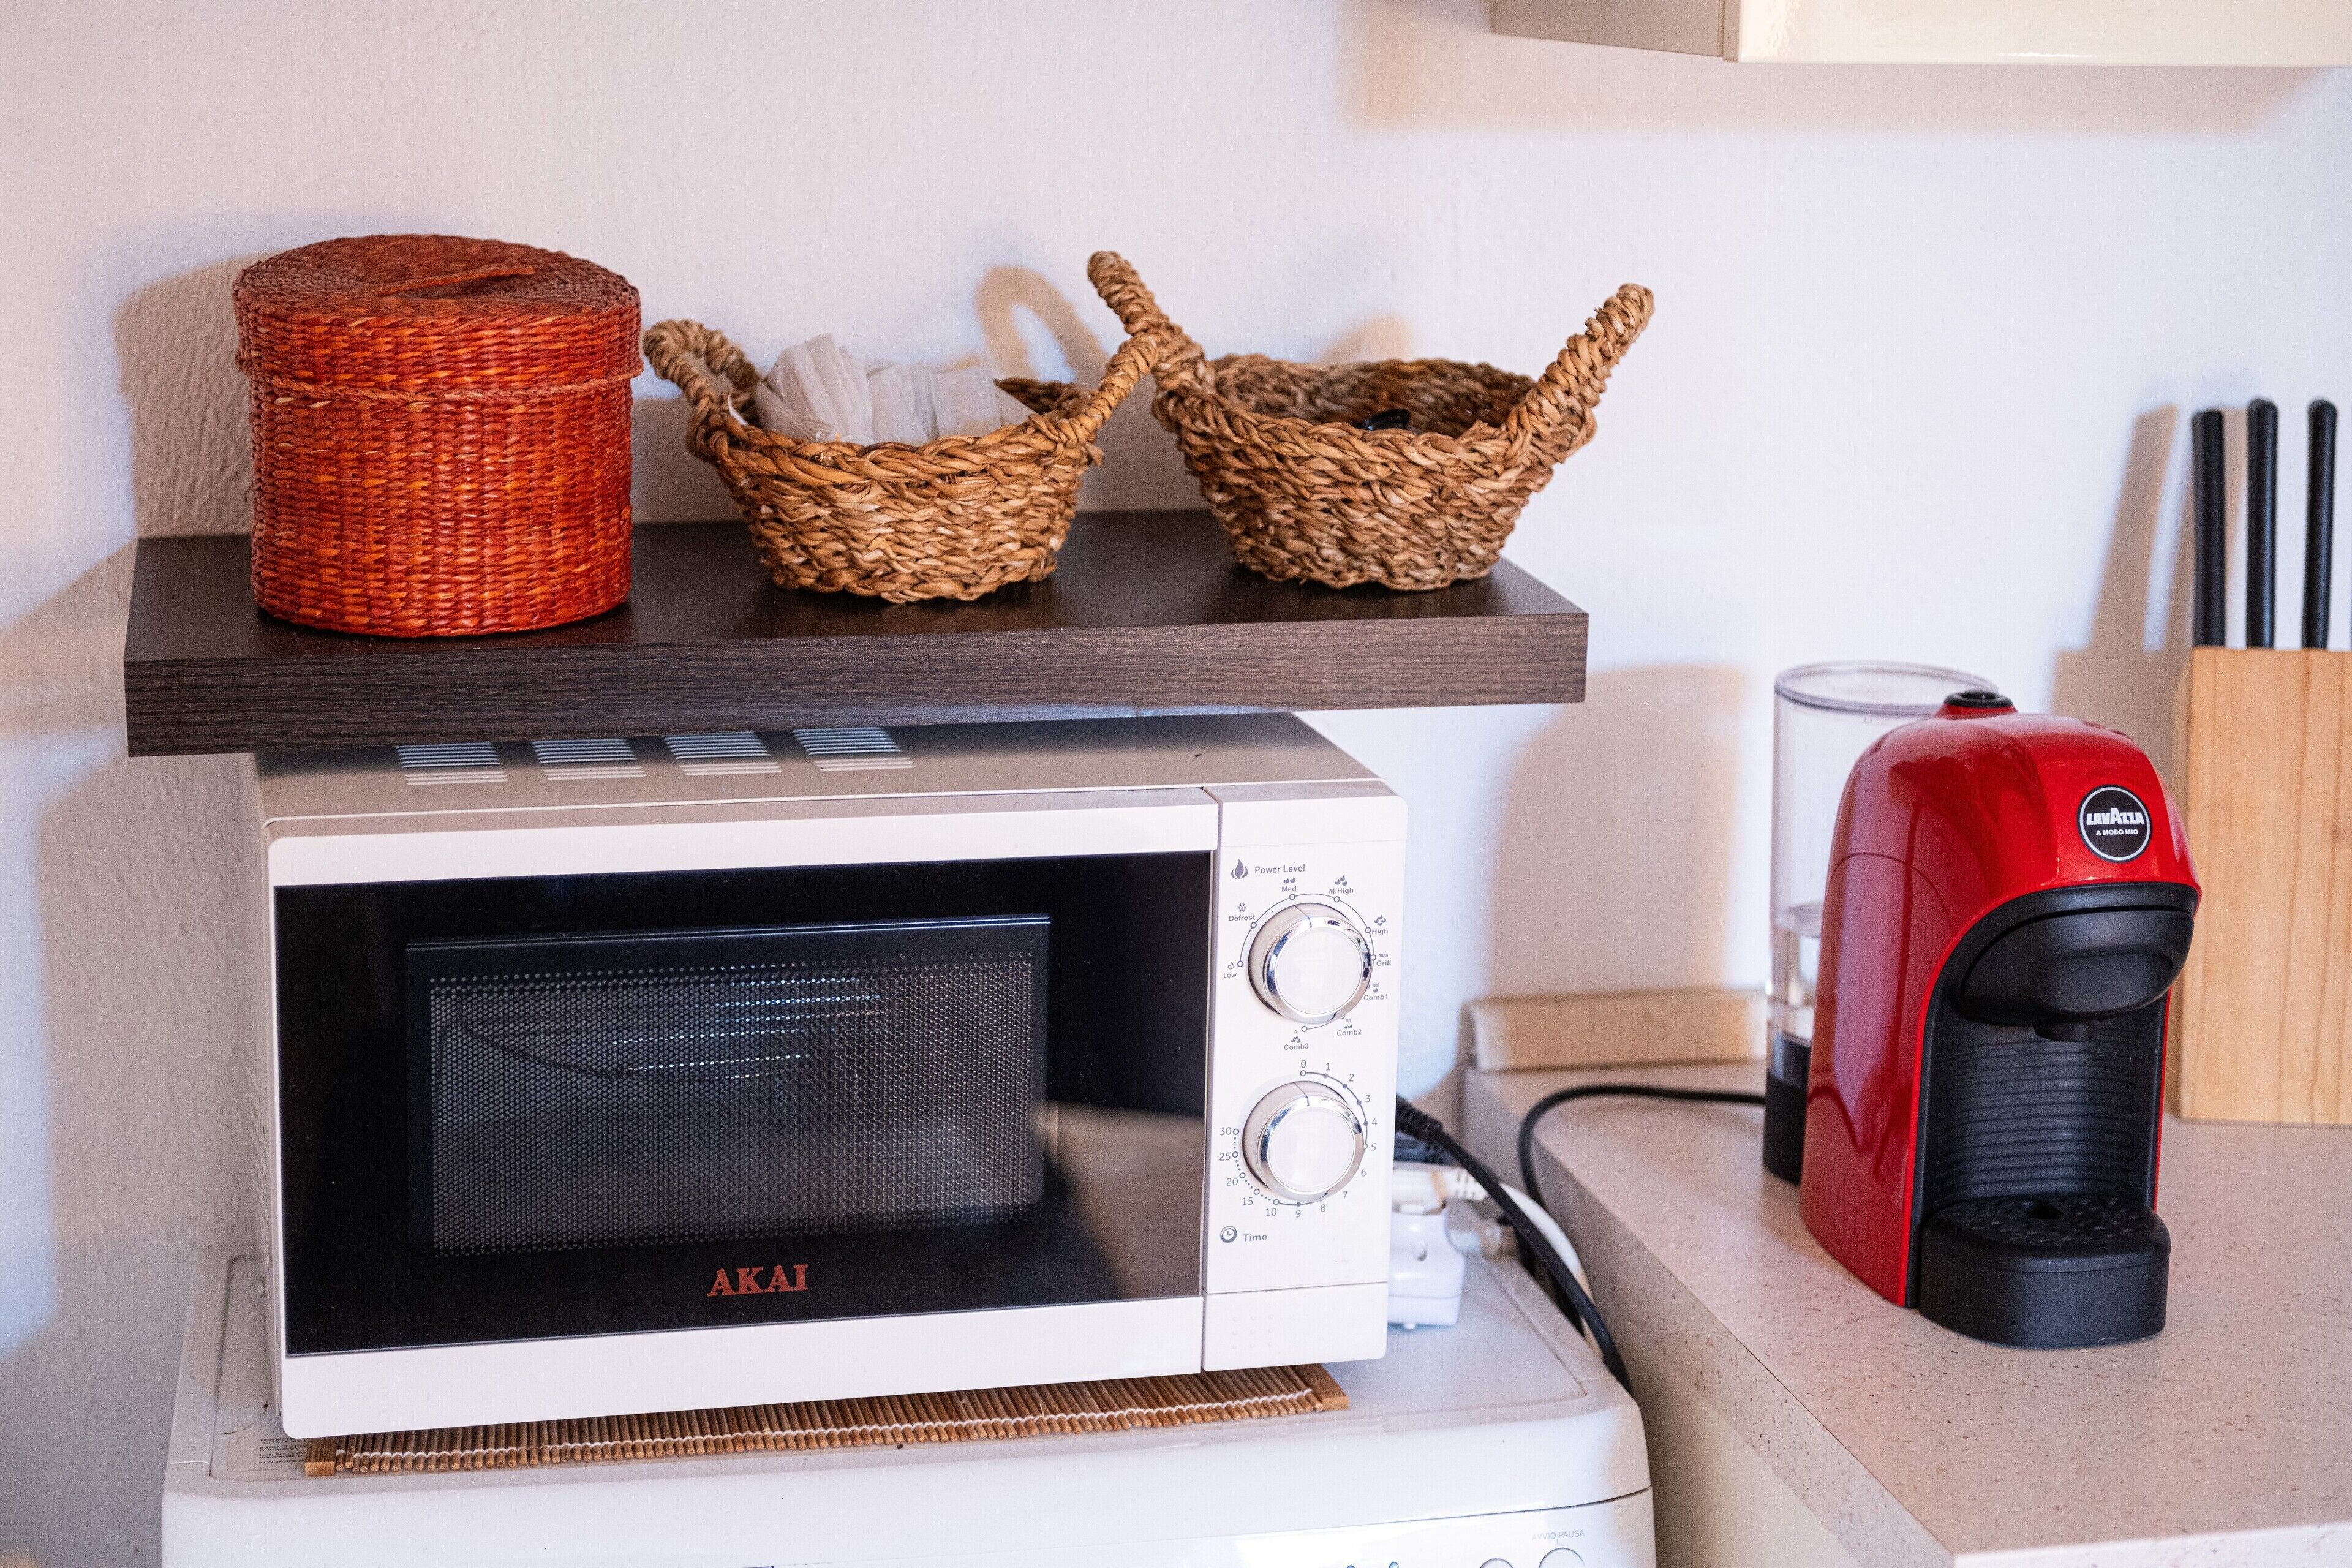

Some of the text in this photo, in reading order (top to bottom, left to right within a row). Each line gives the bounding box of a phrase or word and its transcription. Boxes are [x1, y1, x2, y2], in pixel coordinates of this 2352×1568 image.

[2087, 808, 2145, 825] LAVAZZA
[1219, 1152, 1231, 1161] 25
[1266, 1208, 1276, 1216] 10
[707, 1264, 809, 1297] AKAI
[1558, 1529, 1585, 1538] PAUSA
